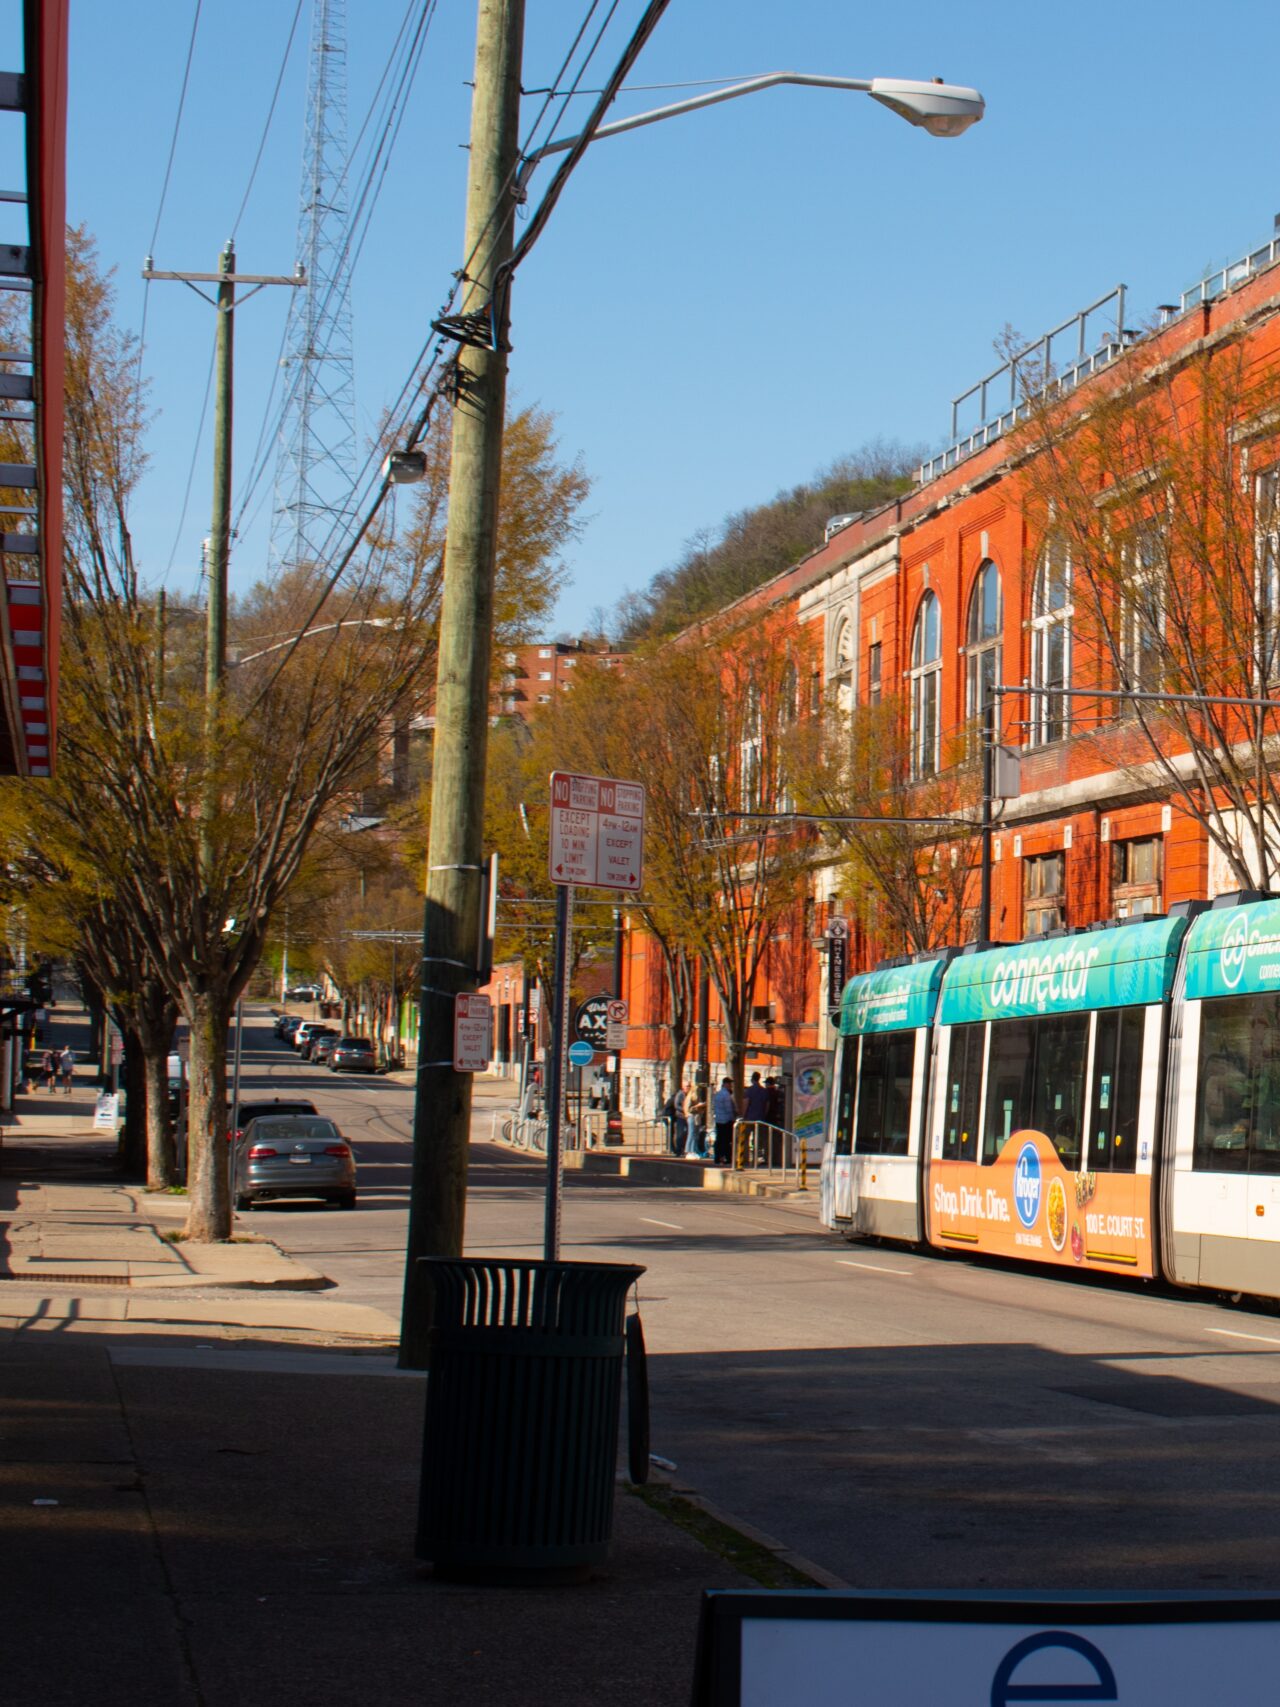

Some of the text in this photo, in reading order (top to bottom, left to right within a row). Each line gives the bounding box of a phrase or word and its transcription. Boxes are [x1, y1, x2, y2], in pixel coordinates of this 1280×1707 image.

[554, 780, 569, 801] NO
[601, 788, 614, 808] NO
[618, 801, 640, 812] PARKING
[560, 810, 590, 825] EXCEPT
[560, 824, 590, 838] LOADING
[562, 838, 568, 849] 10
[606, 838, 633, 849] EXCEPT
[565, 854, 583, 864] LIMIT
[608, 855, 631, 866] VALET
[991, 942, 1099, 1007] connector
[934, 1183, 1010, 1222] Shop. Drink. Dine.
[1086, 1214, 1145, 1238] 100 E. COURT ST.
